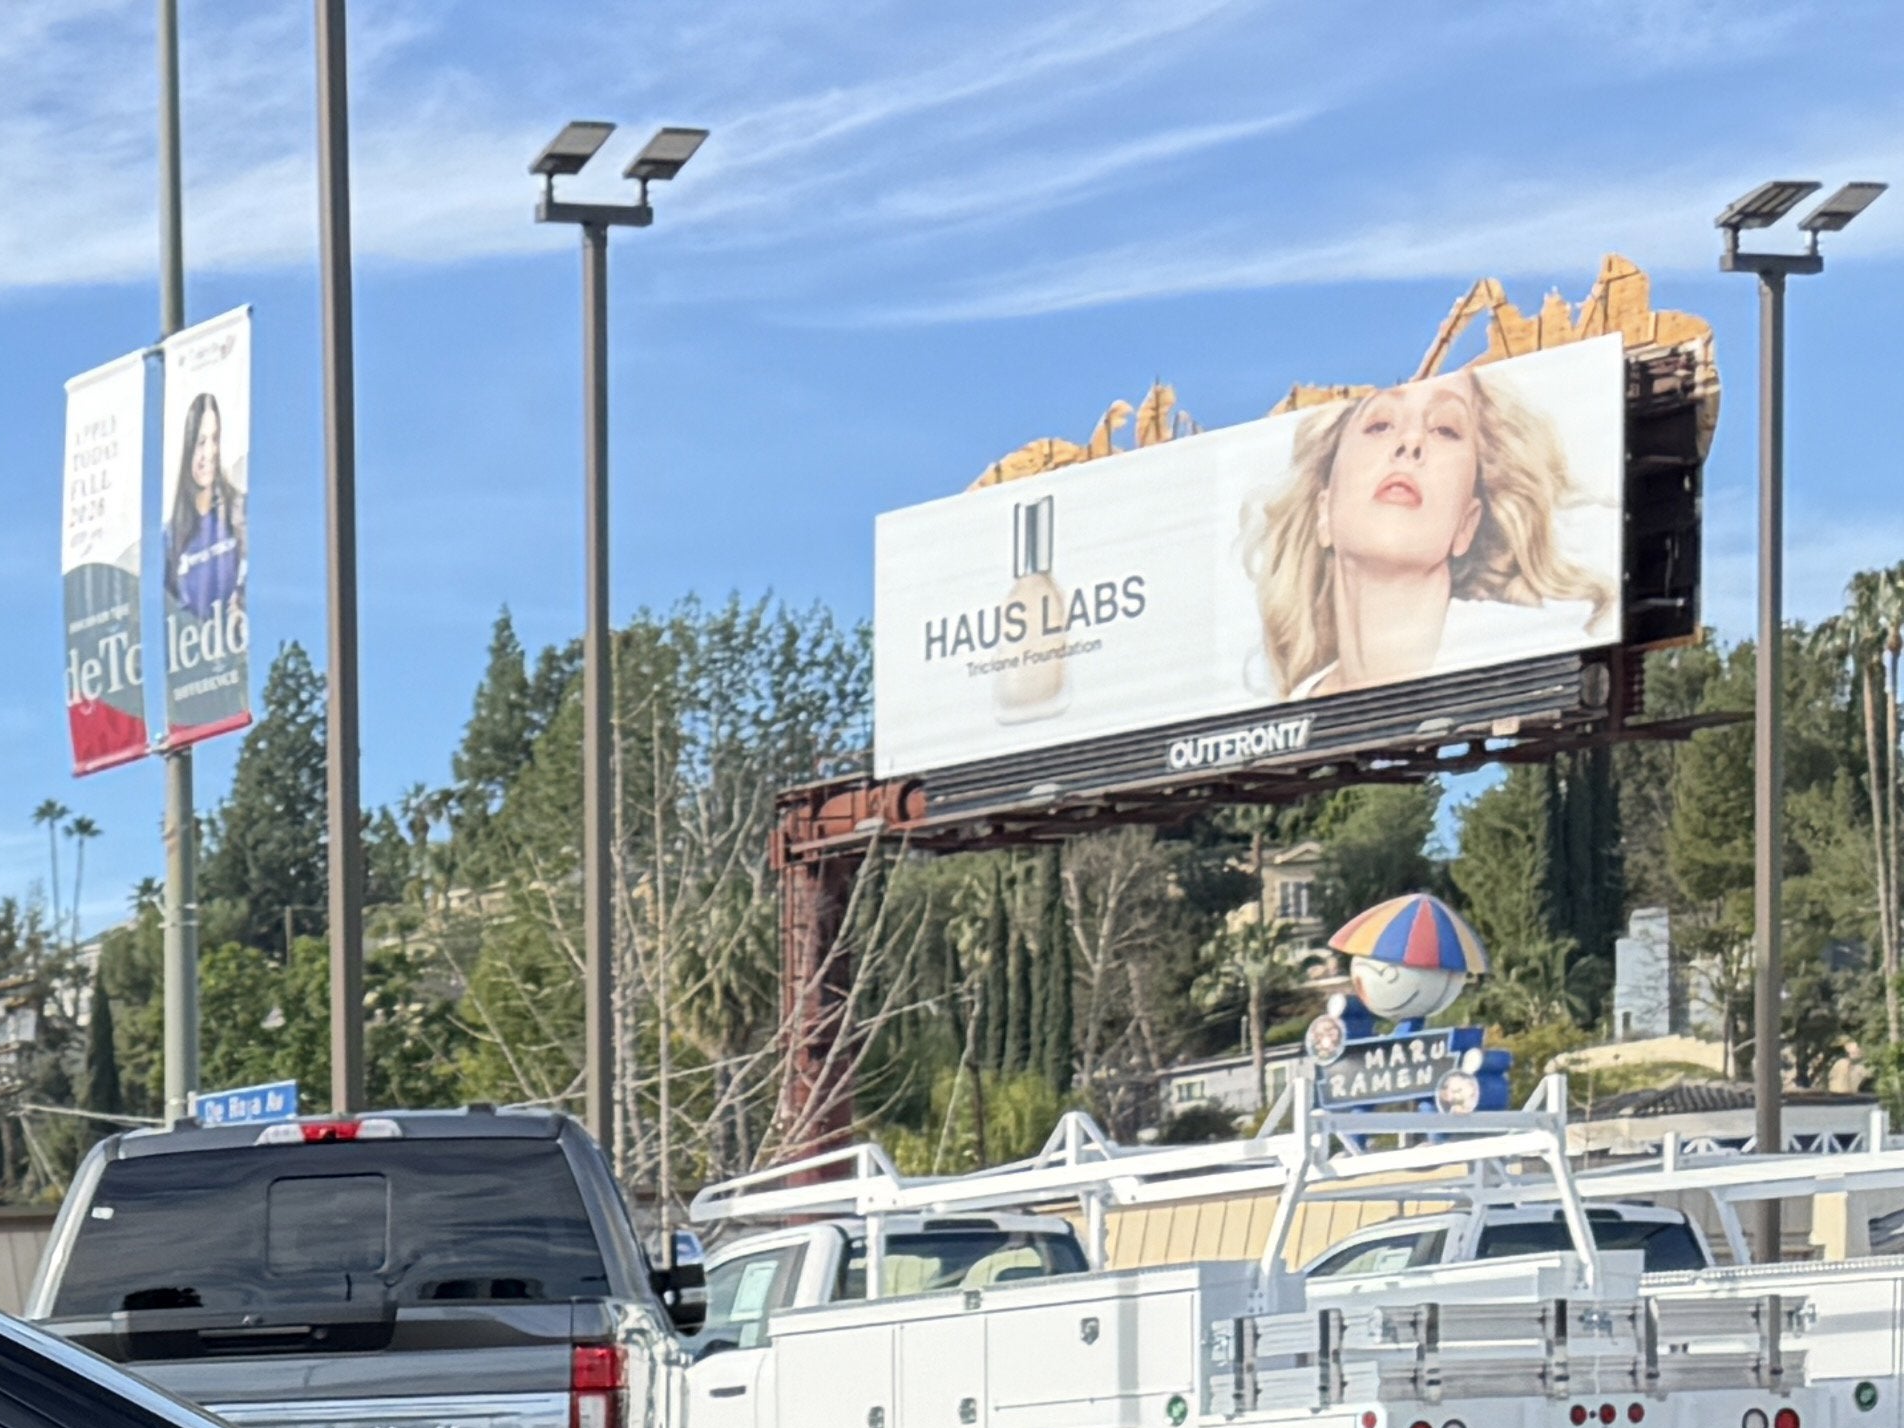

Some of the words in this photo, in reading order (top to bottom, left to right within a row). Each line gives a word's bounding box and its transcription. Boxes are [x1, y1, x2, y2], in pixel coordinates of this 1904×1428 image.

[925, 601, 1027, 661] HAUS
[1041, 575, 1146, 636] LABS
[1022, 638, 1103, 666] Foundation
[1365, 1039, 1446, 1070] MARU
[1328, 1065, 1433, 1098] RAMEN
